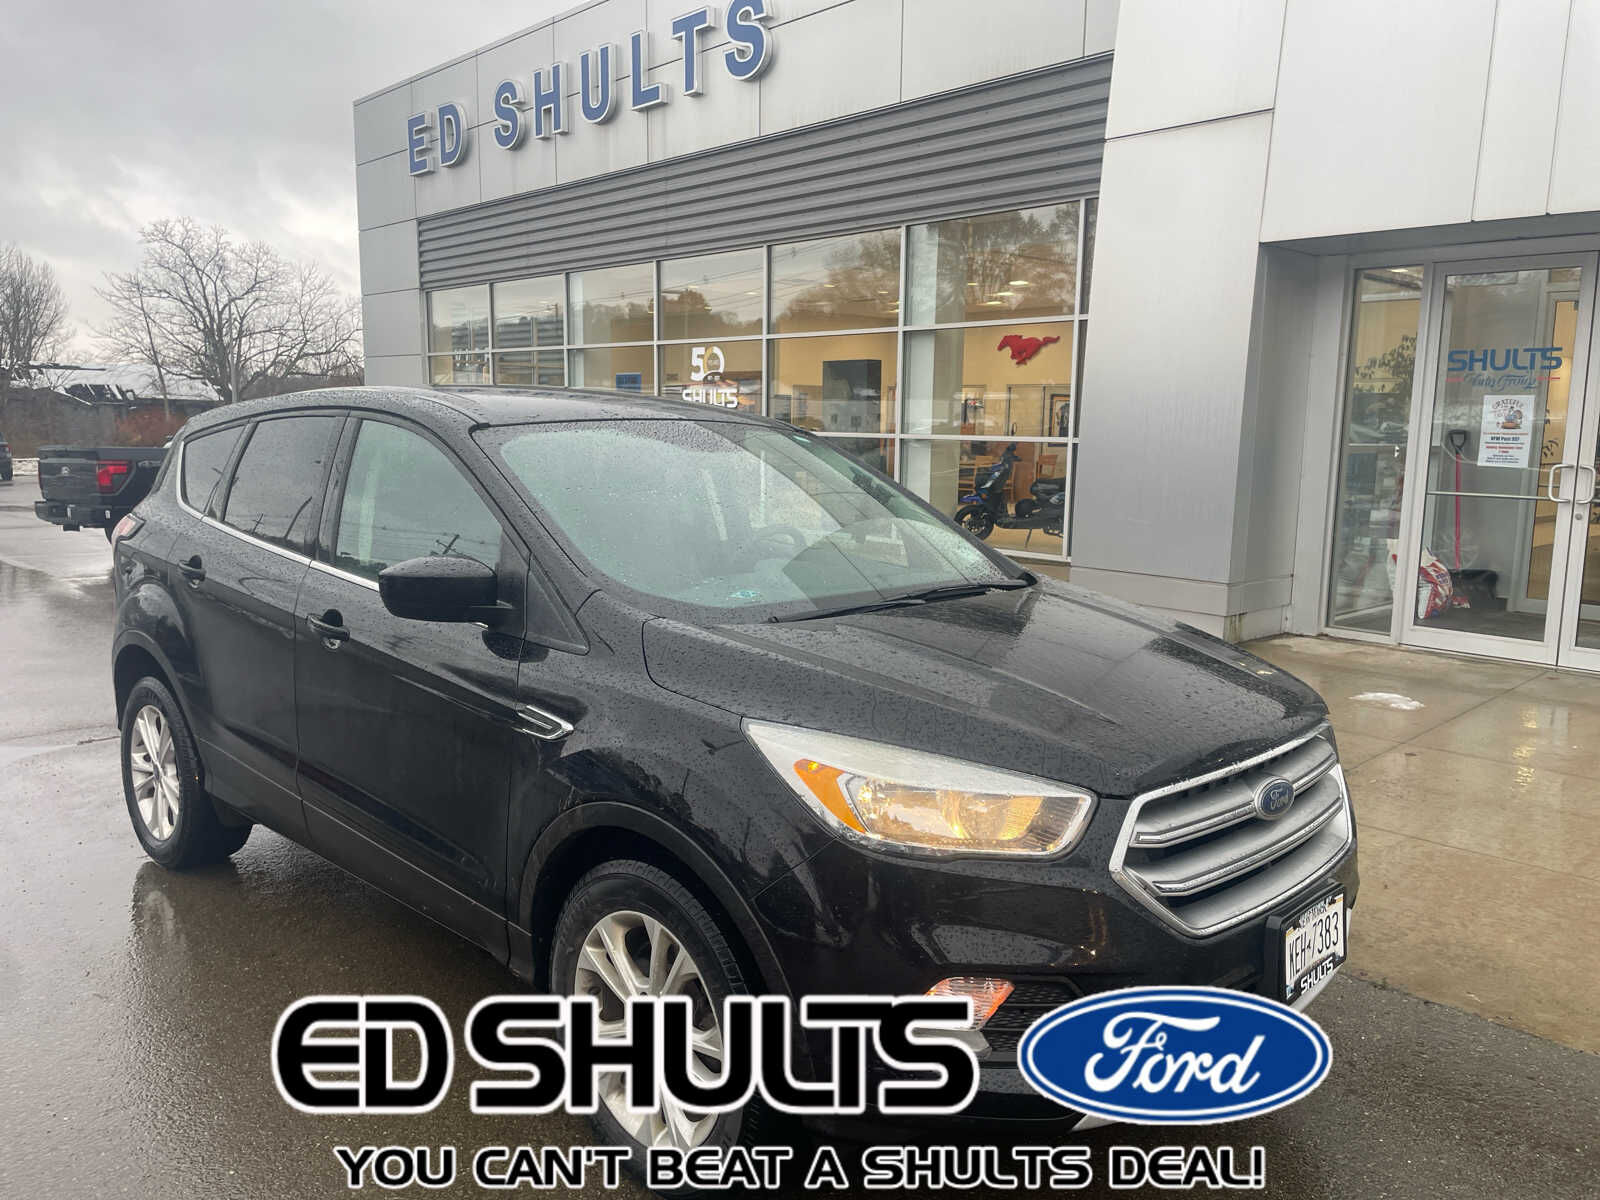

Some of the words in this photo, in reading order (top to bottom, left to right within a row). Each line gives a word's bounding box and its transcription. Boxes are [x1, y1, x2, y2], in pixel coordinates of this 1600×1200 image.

[407, 102, 466, 176] ED
[493, 0, 774, 151] SHULTS
[690, 346, 725, 381] 50
[1447, 347, 1563, 371] SHULTS
[1300, 956, 1334, 995] SHULTS
